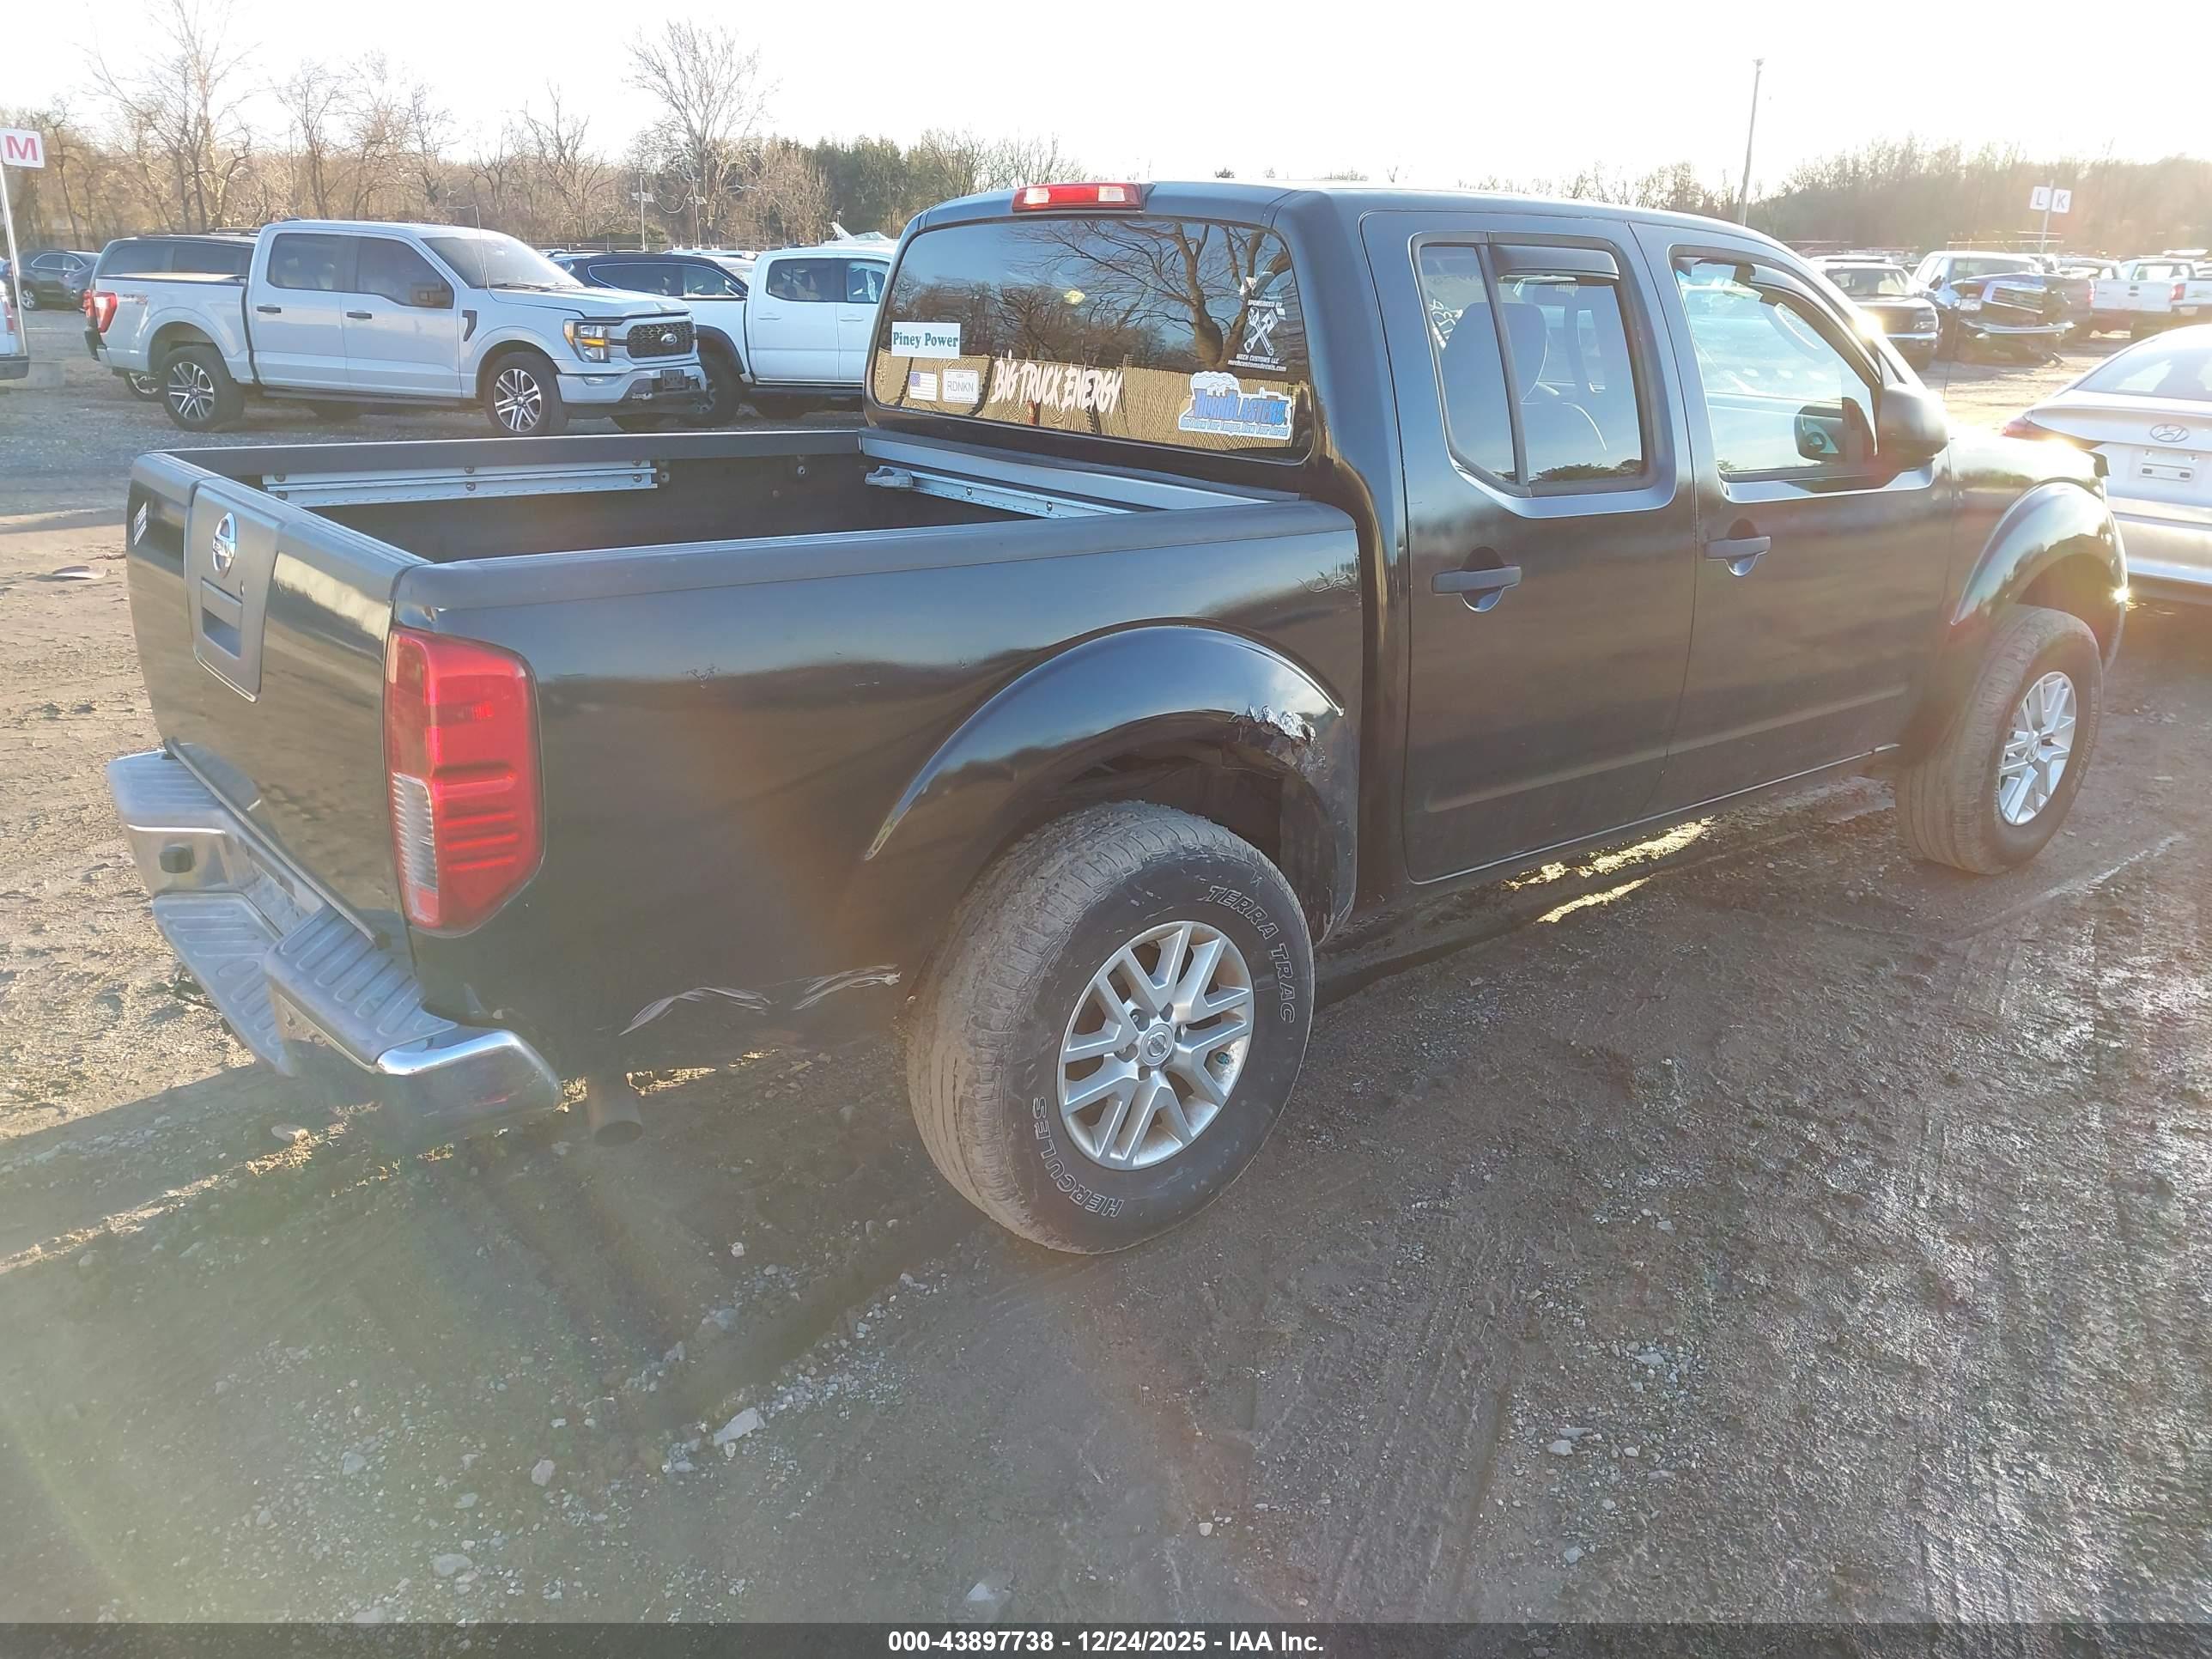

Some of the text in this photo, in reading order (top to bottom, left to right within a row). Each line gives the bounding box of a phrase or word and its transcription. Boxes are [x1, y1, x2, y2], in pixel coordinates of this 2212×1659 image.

[5, 135, 38, 161] M
[2035, 191, 2044, 206] L
[2056, 192, 2067, 209] K
[893, 331, 958, 349] Piney Power
[946, 380, 974, 392] RDNKN
[1018, 357, 1064, 412] TRUCK
[1060, 360, 1124, 418] ENERGY
[1205, 884, 1296, 1024] TERRA TRAC
[1032, 1096, 1125, 1218] HERCULES
